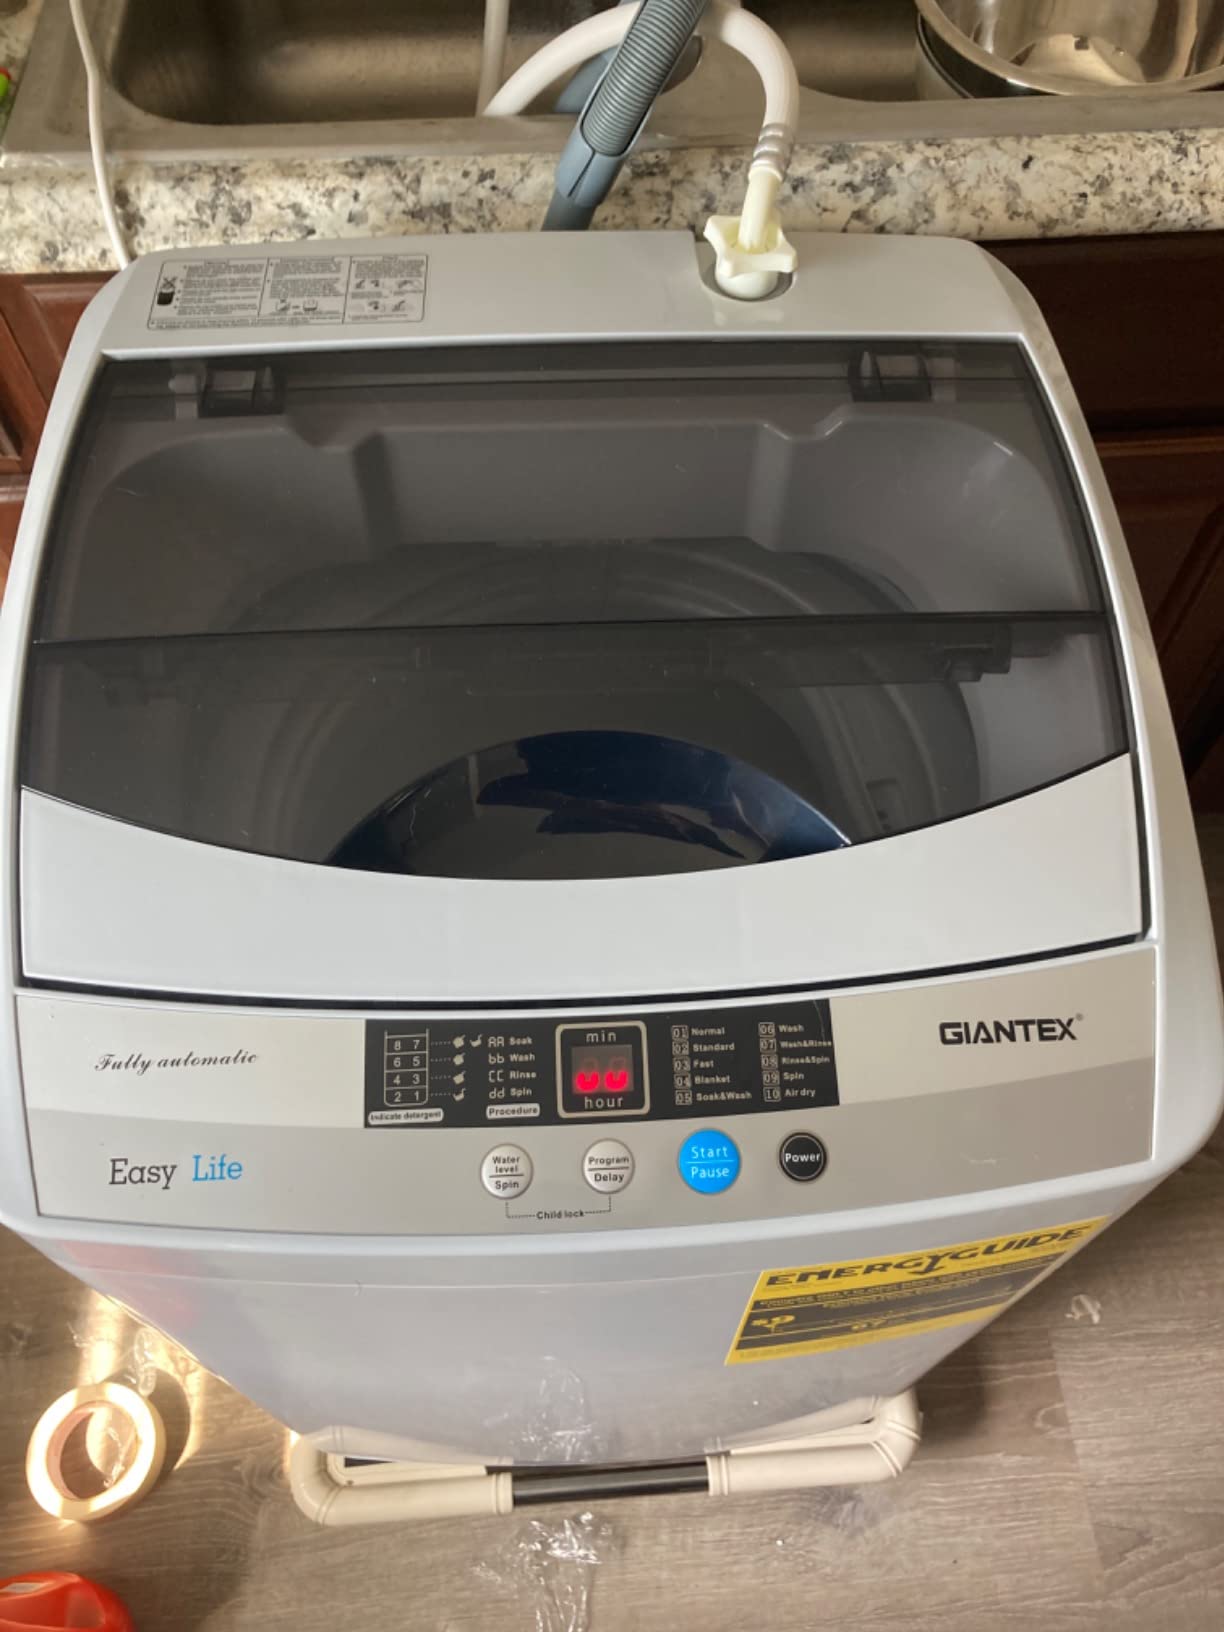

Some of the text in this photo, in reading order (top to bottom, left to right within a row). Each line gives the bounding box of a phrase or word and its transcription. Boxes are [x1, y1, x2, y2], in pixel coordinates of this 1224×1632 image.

[691, 1027, 725, 1036] Normal
[779, 1024, 804, 1033] Wash
[939, 1018, 1077, 1045] GIANTEX
[509, 1036, 533, 1046] Soak
[586, 1030, 617, 1043] min
[394, 1039, 420, 1051] 8 7
[693, 1043, 735, 1052] Standard
[94, 1049, 258, 1076] Fully automatic
[394, 1056, 420, 1068] 6 5
[488, 1053, 535, 1065] bb Wash
[693, 1059, 714, 1068] Fast
[782, 1056, 831, 1065] Rinse&Spin
[393, 1073, 420, 1085] 4 3
[509, 1071, 536, 1080] Rinse
[694, 1075, 731, 1085] Blanket
[783, 1072, 805, 1081] Spin
[395, 1090, 420, 1102] 2 1
[488, 1087, 532, 1099] dd Spin
[696, 1090, 752, 1101] Soak&Wash
[766, 1088, 816, 1099] 10 Air dry
[584, 1096, 624, 1109] hour
[488, 1106, 538, 1117] Procedure
[691, 1145, 729, 1159] Start
[785, 1152, 821, 1163] Power
[492, 1155, 521, 1164] Water
[588, 1155, 630, 1167] Program
[108, 1153, 243, 1190] Easy Life
[495, 1165, 519, 1174] level
[690, 1166, 730, 1179] Pause
[594, 1172, 625, 1183] Delay
[494, 1180, 520, 1191] Spin
[536, 1209, 585, 1220] Child lock
